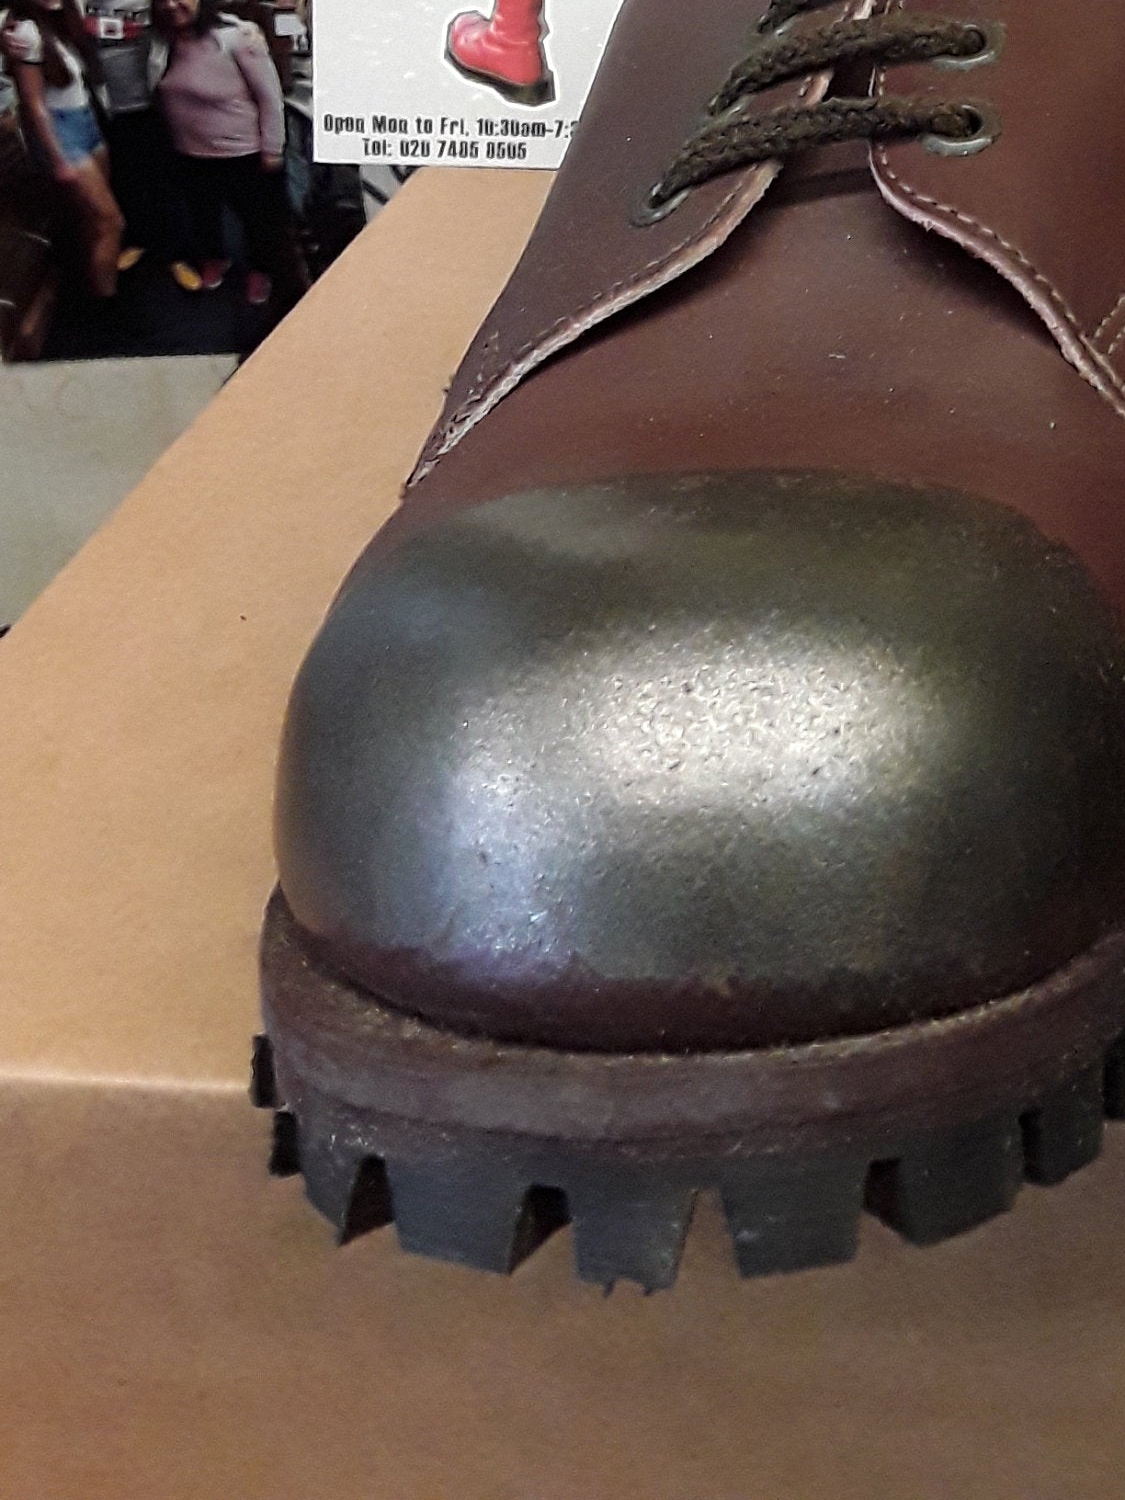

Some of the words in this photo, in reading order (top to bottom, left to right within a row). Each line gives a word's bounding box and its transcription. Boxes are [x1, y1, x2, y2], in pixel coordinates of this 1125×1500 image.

[323, 114, 365, 135] Open
[372, 114, 409, 134] Mon
[416, 116, 433, 134] to
